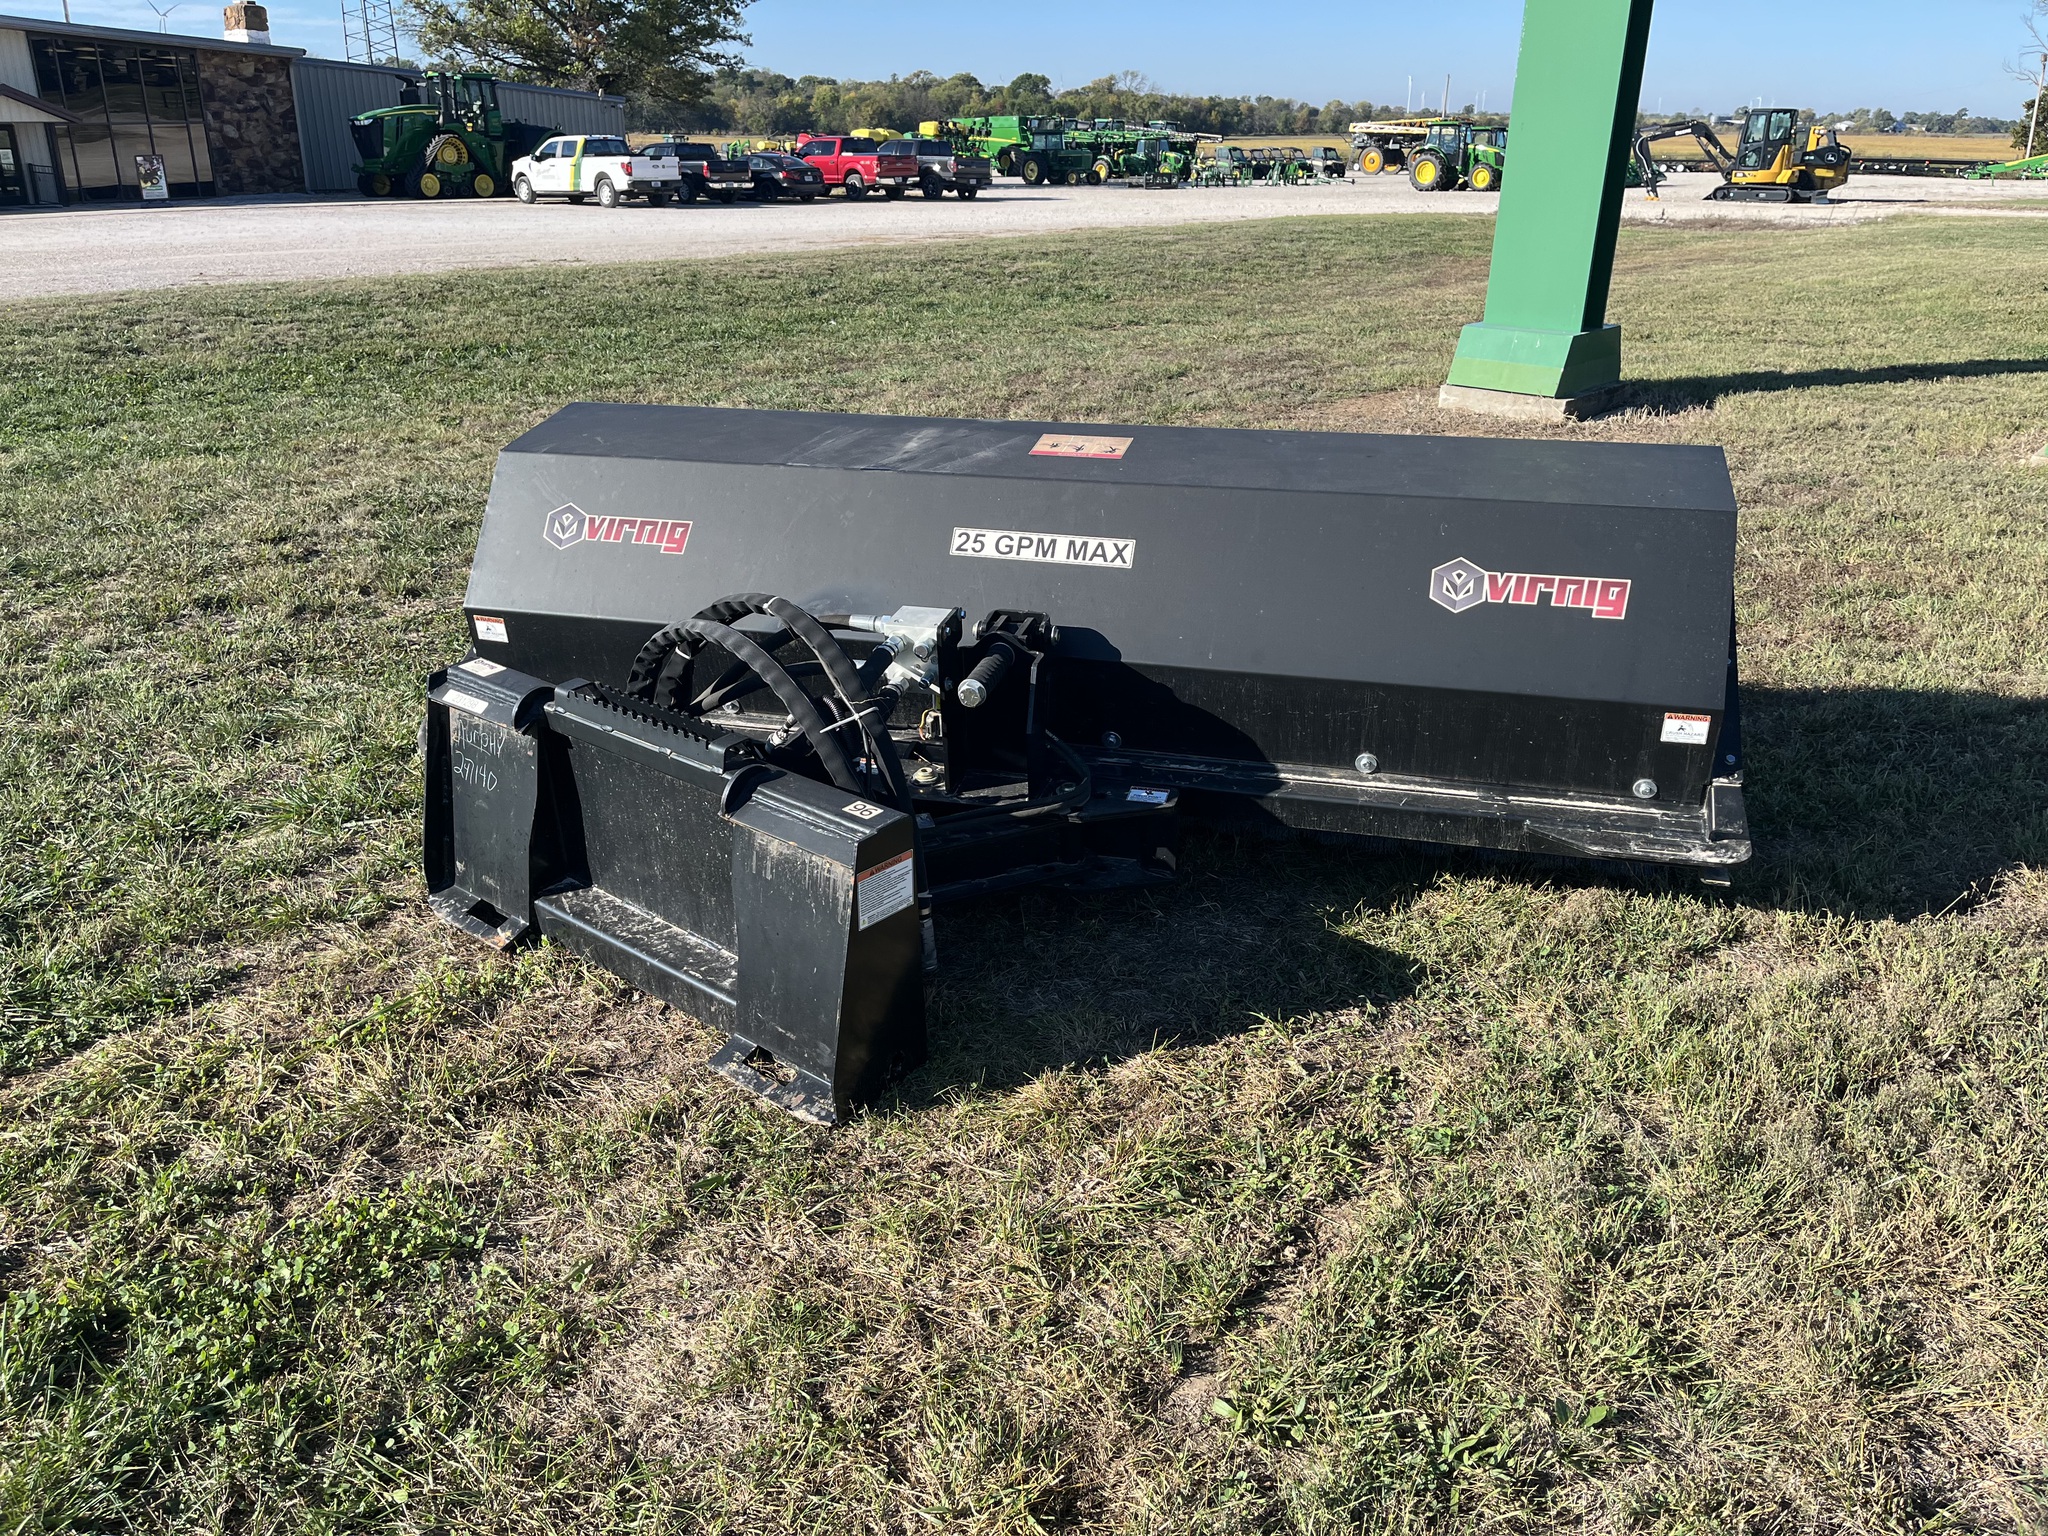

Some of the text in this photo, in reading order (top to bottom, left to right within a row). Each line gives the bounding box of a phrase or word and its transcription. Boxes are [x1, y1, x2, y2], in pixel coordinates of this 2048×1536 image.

[955, 532, 1130, 565] 25 GPM MAX
[1674, 714, 1708, 722] WARNING
